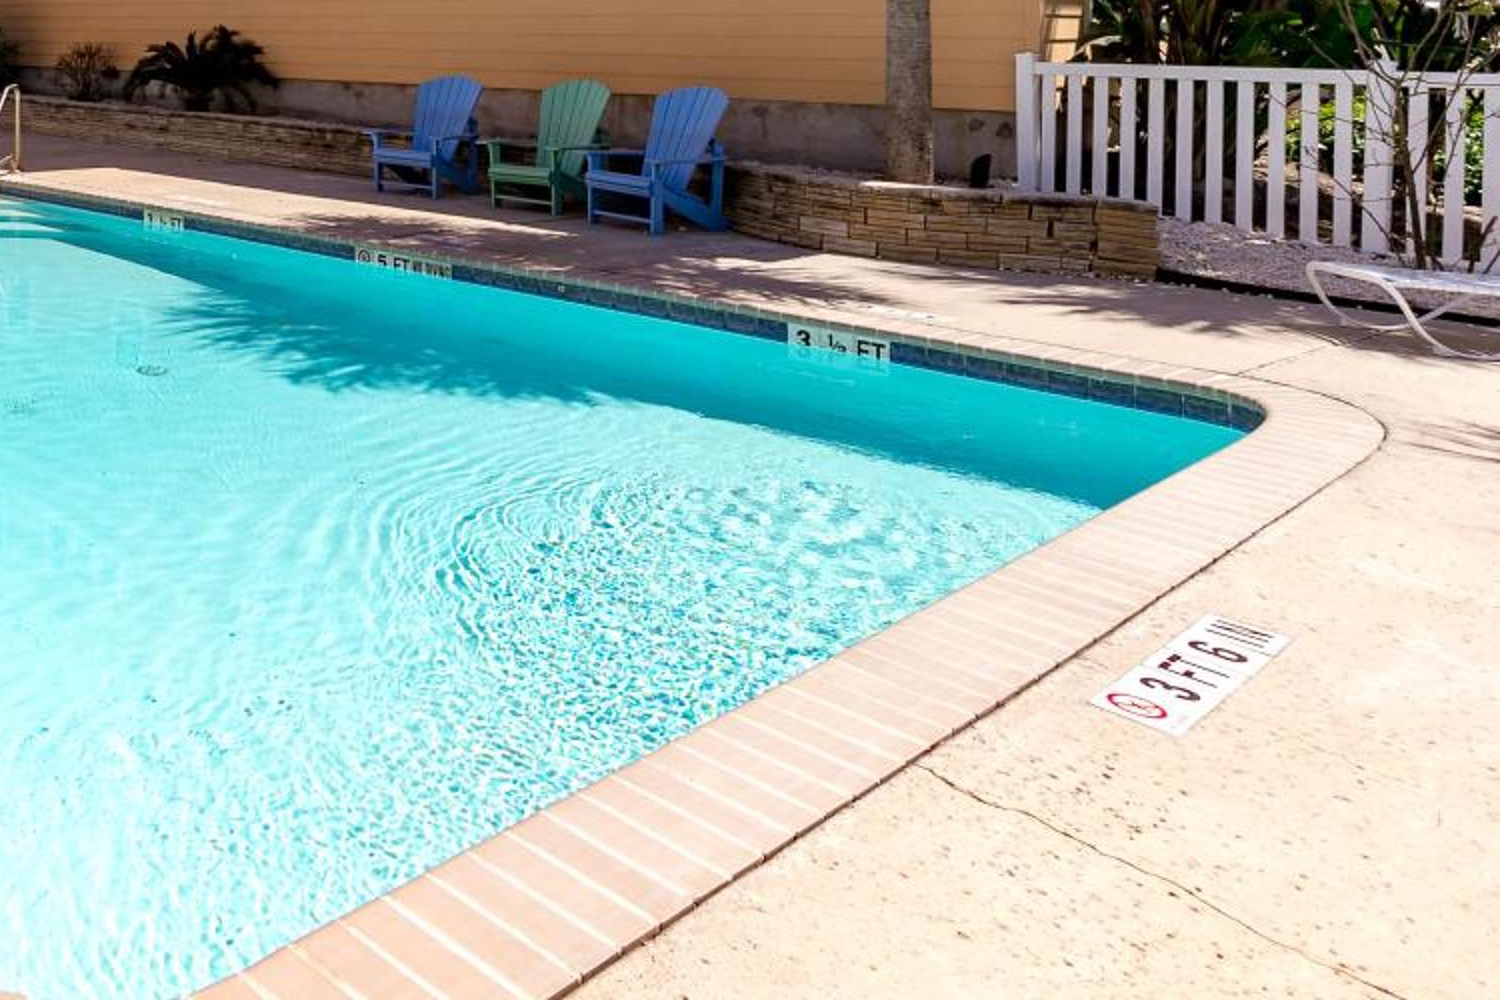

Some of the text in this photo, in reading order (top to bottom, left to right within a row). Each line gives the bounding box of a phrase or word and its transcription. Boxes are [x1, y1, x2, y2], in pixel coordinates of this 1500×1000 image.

[856, 340, 886, 361] FT
[1139, 619, 1276, 702] 3 FT 6 IN
